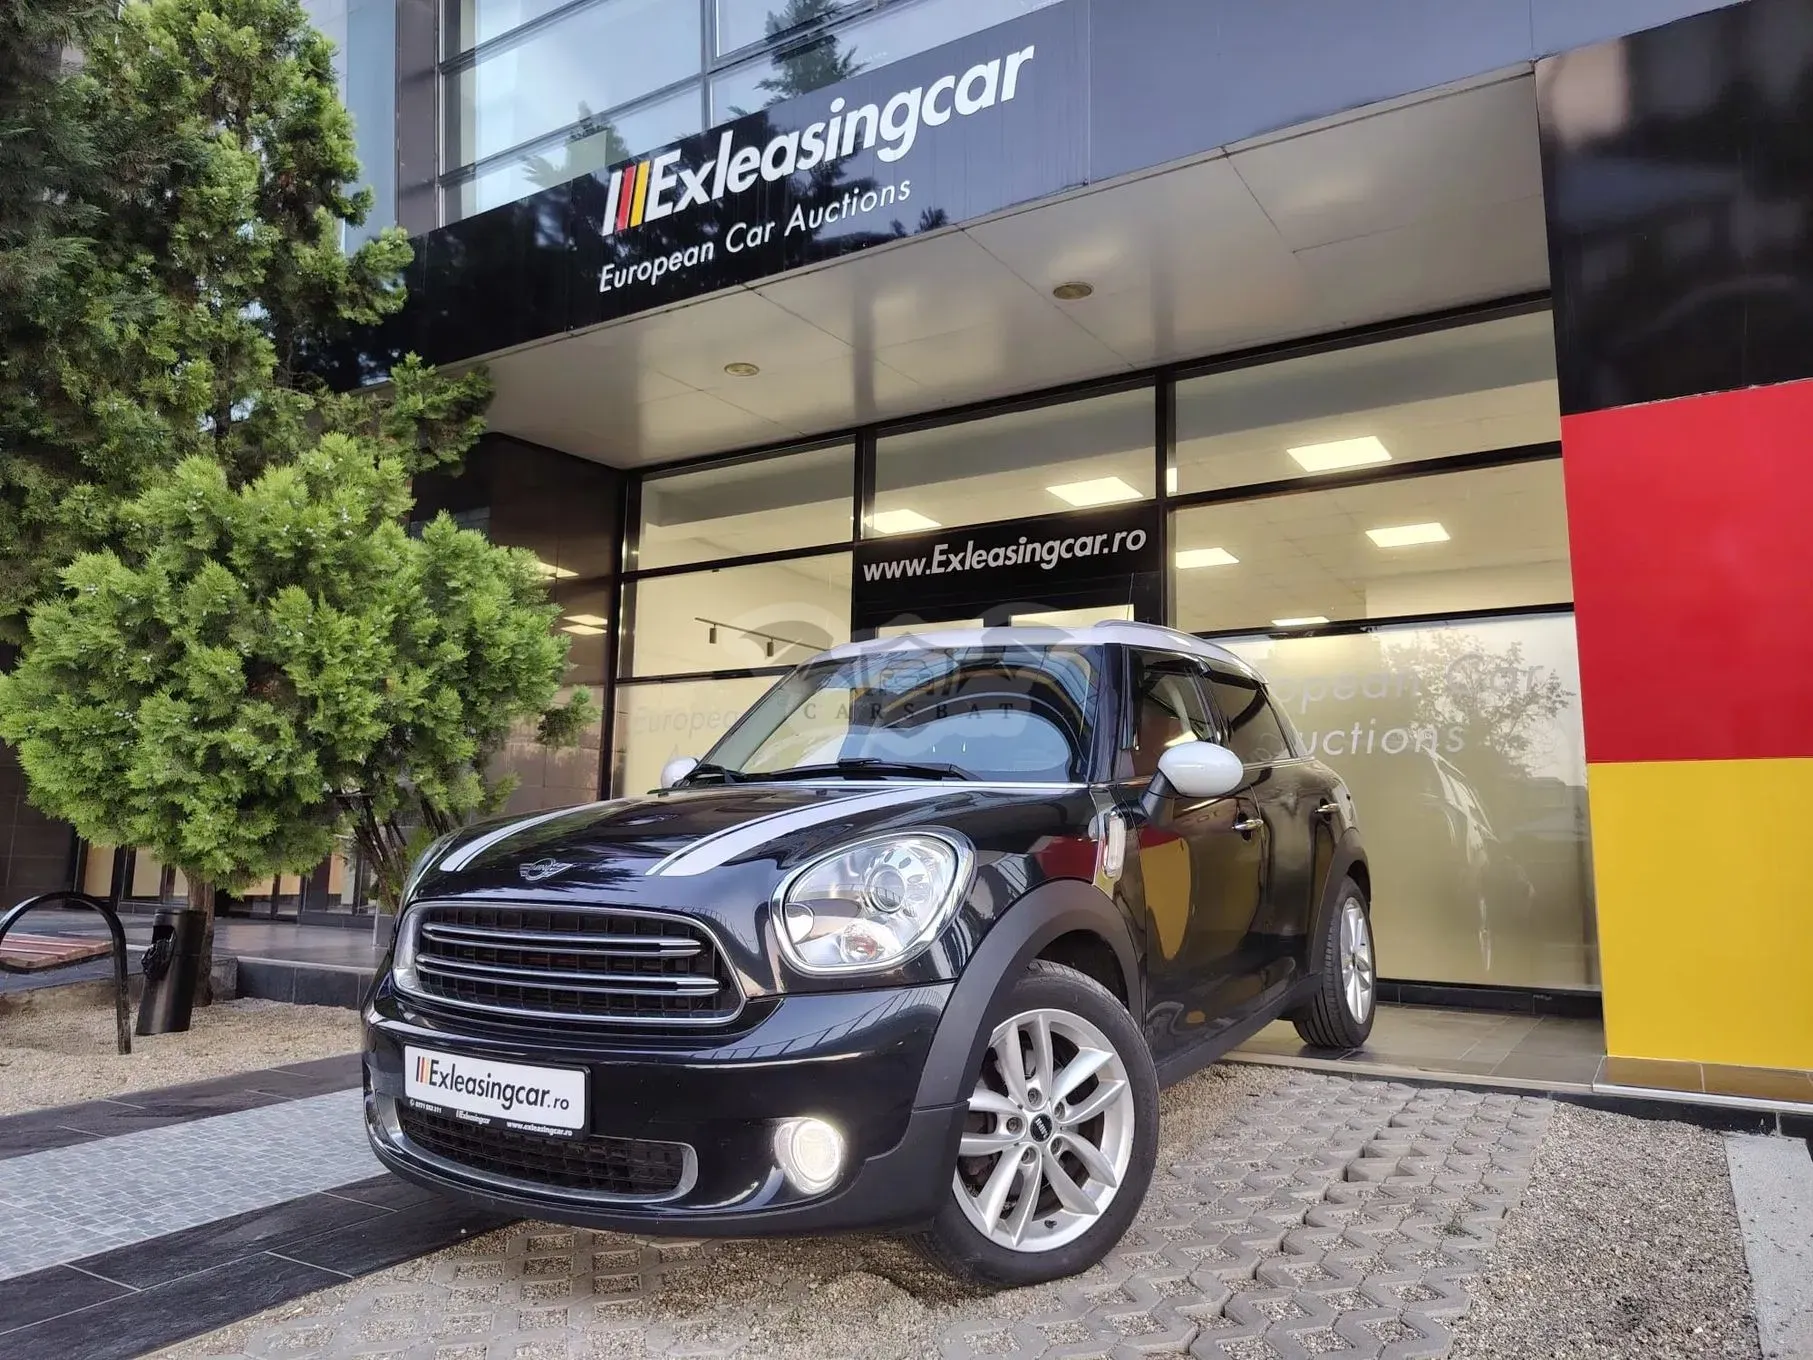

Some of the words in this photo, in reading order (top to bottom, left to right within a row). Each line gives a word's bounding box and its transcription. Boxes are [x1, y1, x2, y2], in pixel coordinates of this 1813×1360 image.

[644, 45, 1035, 222] Exleasingcar
[599, 238, 714, 293] European
[726, 221, 776, 254] Car
[784, 180, 911, 237] Auctions
[863, 528, 1147, 582] www.Exleasingcar.ro
[430, 1060, 569, 1110] Exleasingcar.ro
